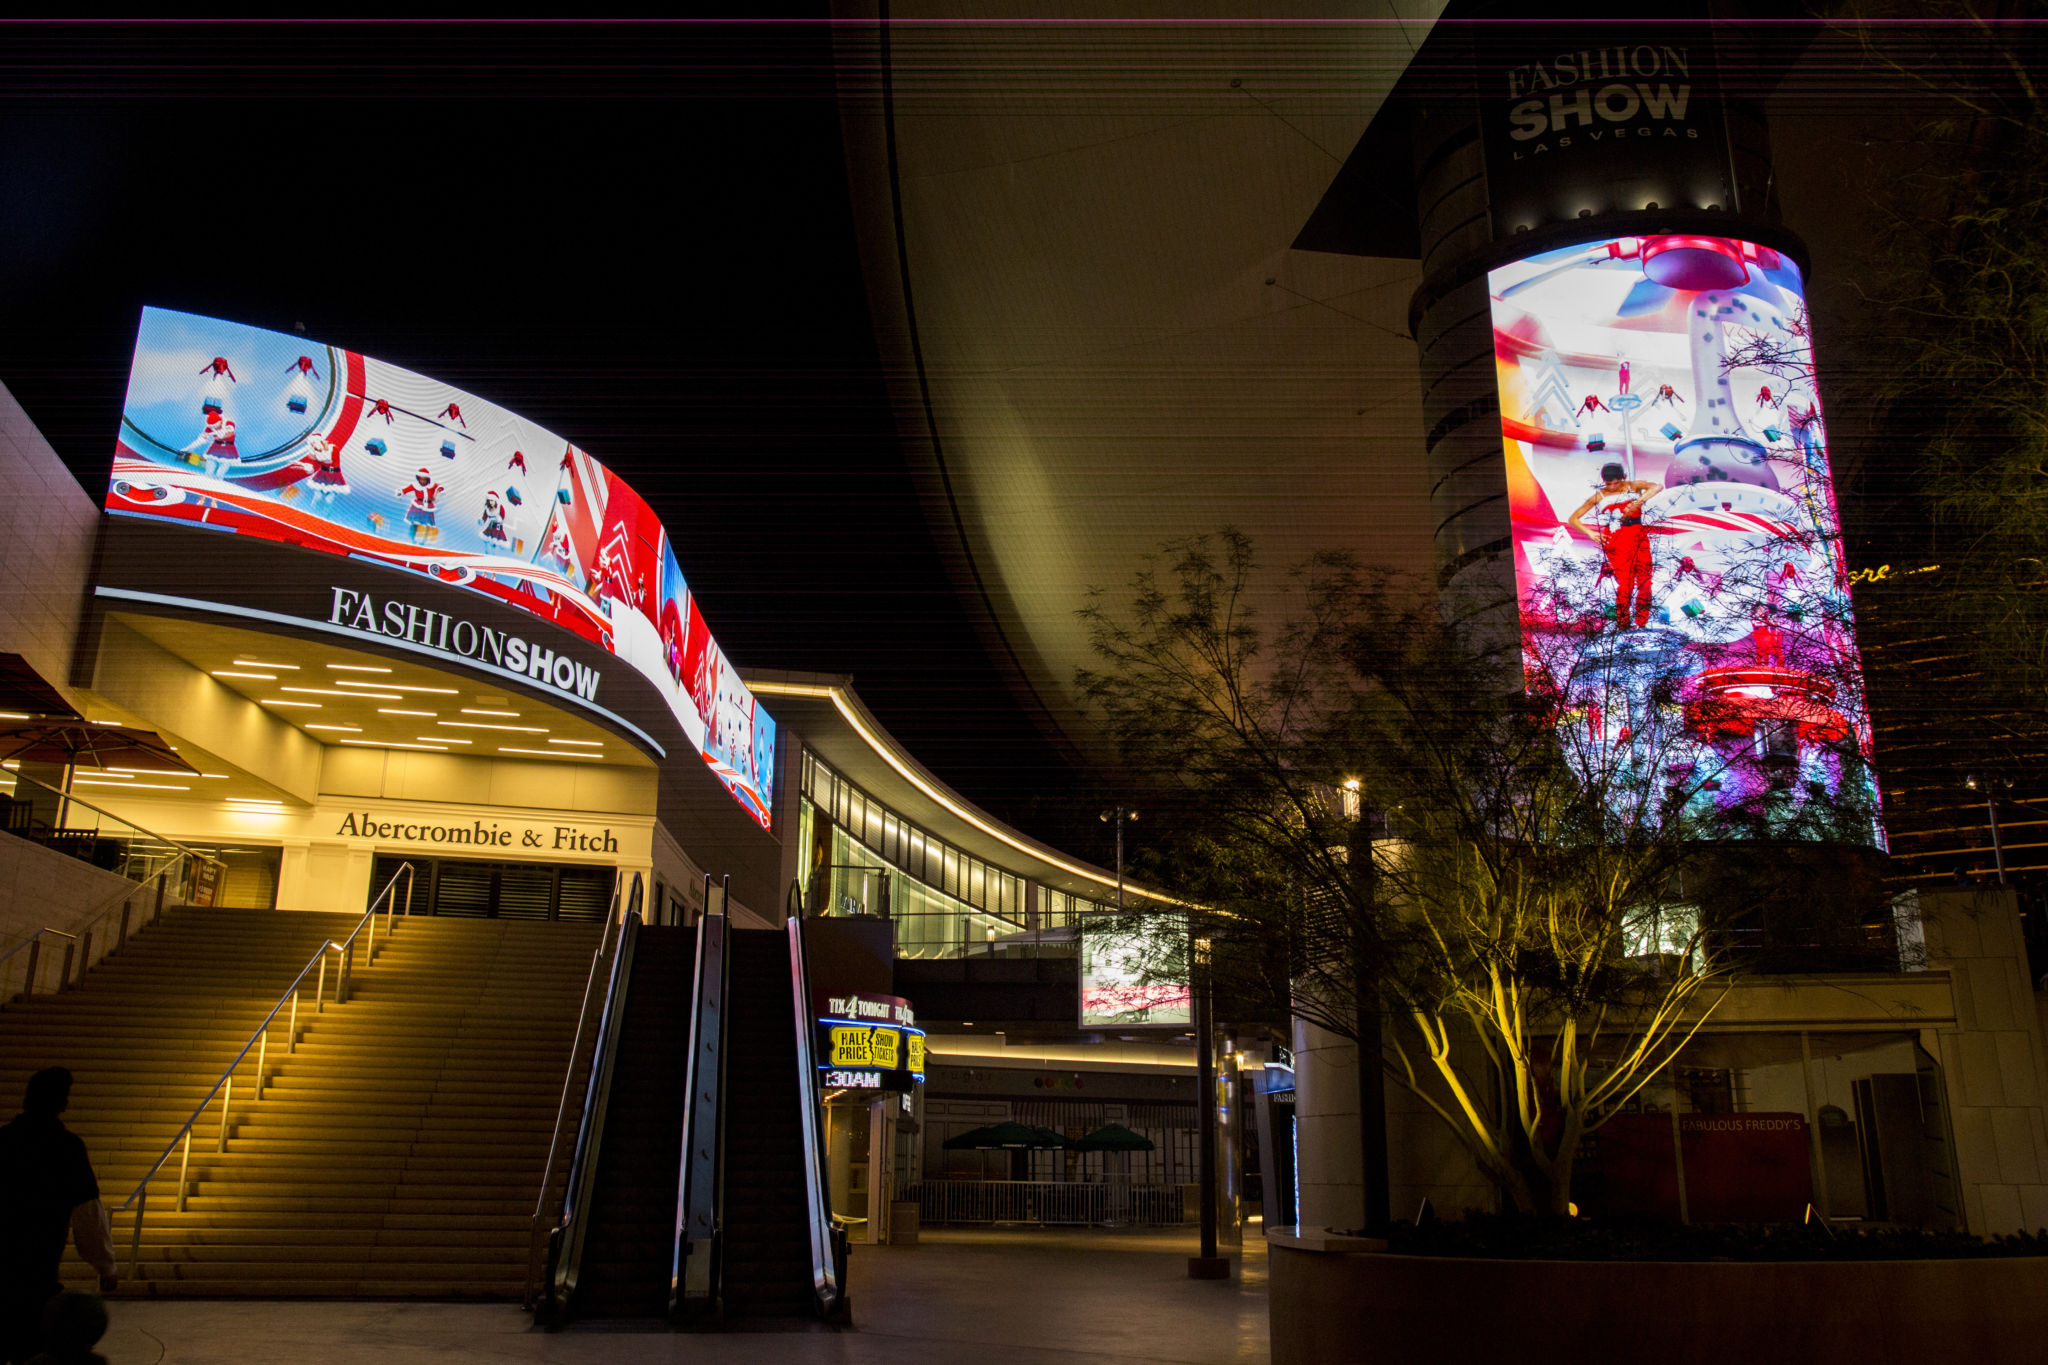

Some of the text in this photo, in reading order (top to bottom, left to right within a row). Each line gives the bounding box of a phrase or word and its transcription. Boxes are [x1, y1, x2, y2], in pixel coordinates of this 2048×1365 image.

[1507, 46, 1689, 100] FASHION
[1510, 84, 1691, 141] SHOW
[1513, 127, 1699, 161] LAS VEGAS
[336, 812, 619, 853] Abercrombie & Fitch
[829, 996, 890, 1019] TIX 4 TONIGHT
[841, 1032, 867, 1046] HALF
[875, 1033, 893, 1048] SHOW
[839, 1046, 868, 1060] PRICE
[873, 1046, 894, 1062] TICKETS
[1273, 1093, 1296, 1103] FASHI
[1682, 1119, 1801, 1131] FABULOUS FREDDY'S
